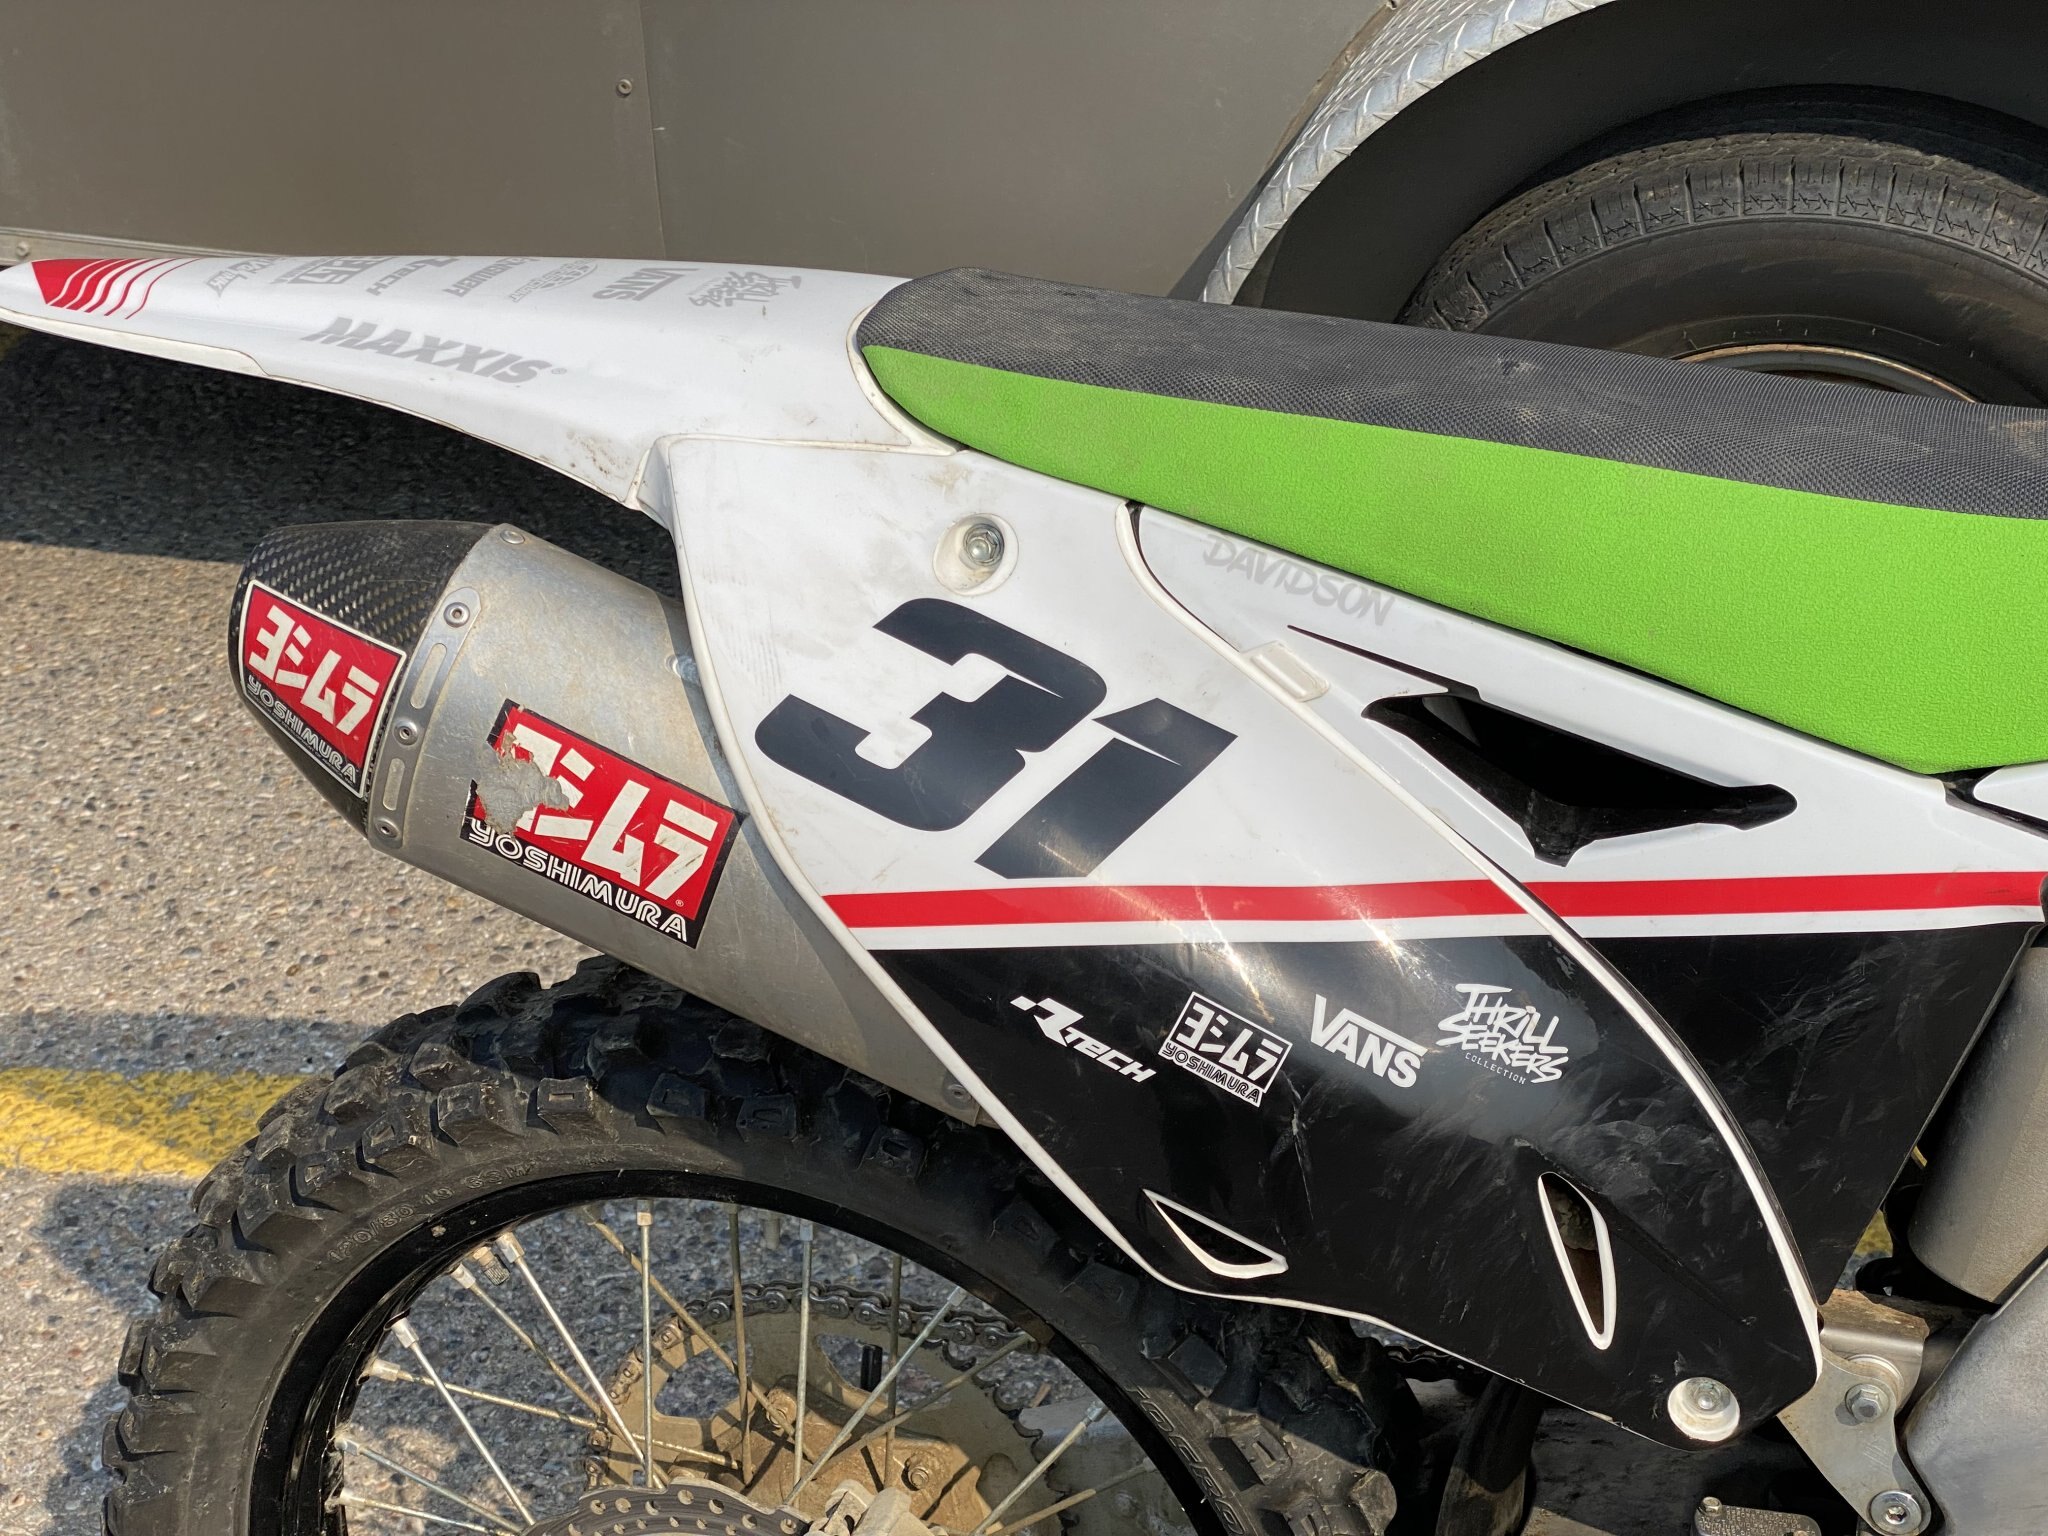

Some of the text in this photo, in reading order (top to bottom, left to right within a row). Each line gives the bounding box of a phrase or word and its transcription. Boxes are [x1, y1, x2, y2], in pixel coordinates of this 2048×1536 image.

[593, 268, 699, 301] VANS
[300, 317, 552, 383] MAXXIS
[1202, 533, 1395, 626] DAVIDSON
[247, 605, 379, 735] ヨシムラ
[247, 675, 356, 783] YOSHIMURA
[755, 597, 1239, 879] 31
[513, 722, 717, 900] シムラ
[469, 818, 687, 942] YOSHIMURA
[1162, 1042, 1261, 1103] YOSHIMURA
[1176, 1002, 1283, 1081] ヨシムラ
[1310, 994, 1428, 1088] VANS
[1436, 1012, 1568, 1083] SEEKERS
[1465, 1052, 1527, 1085] COLLECTION
